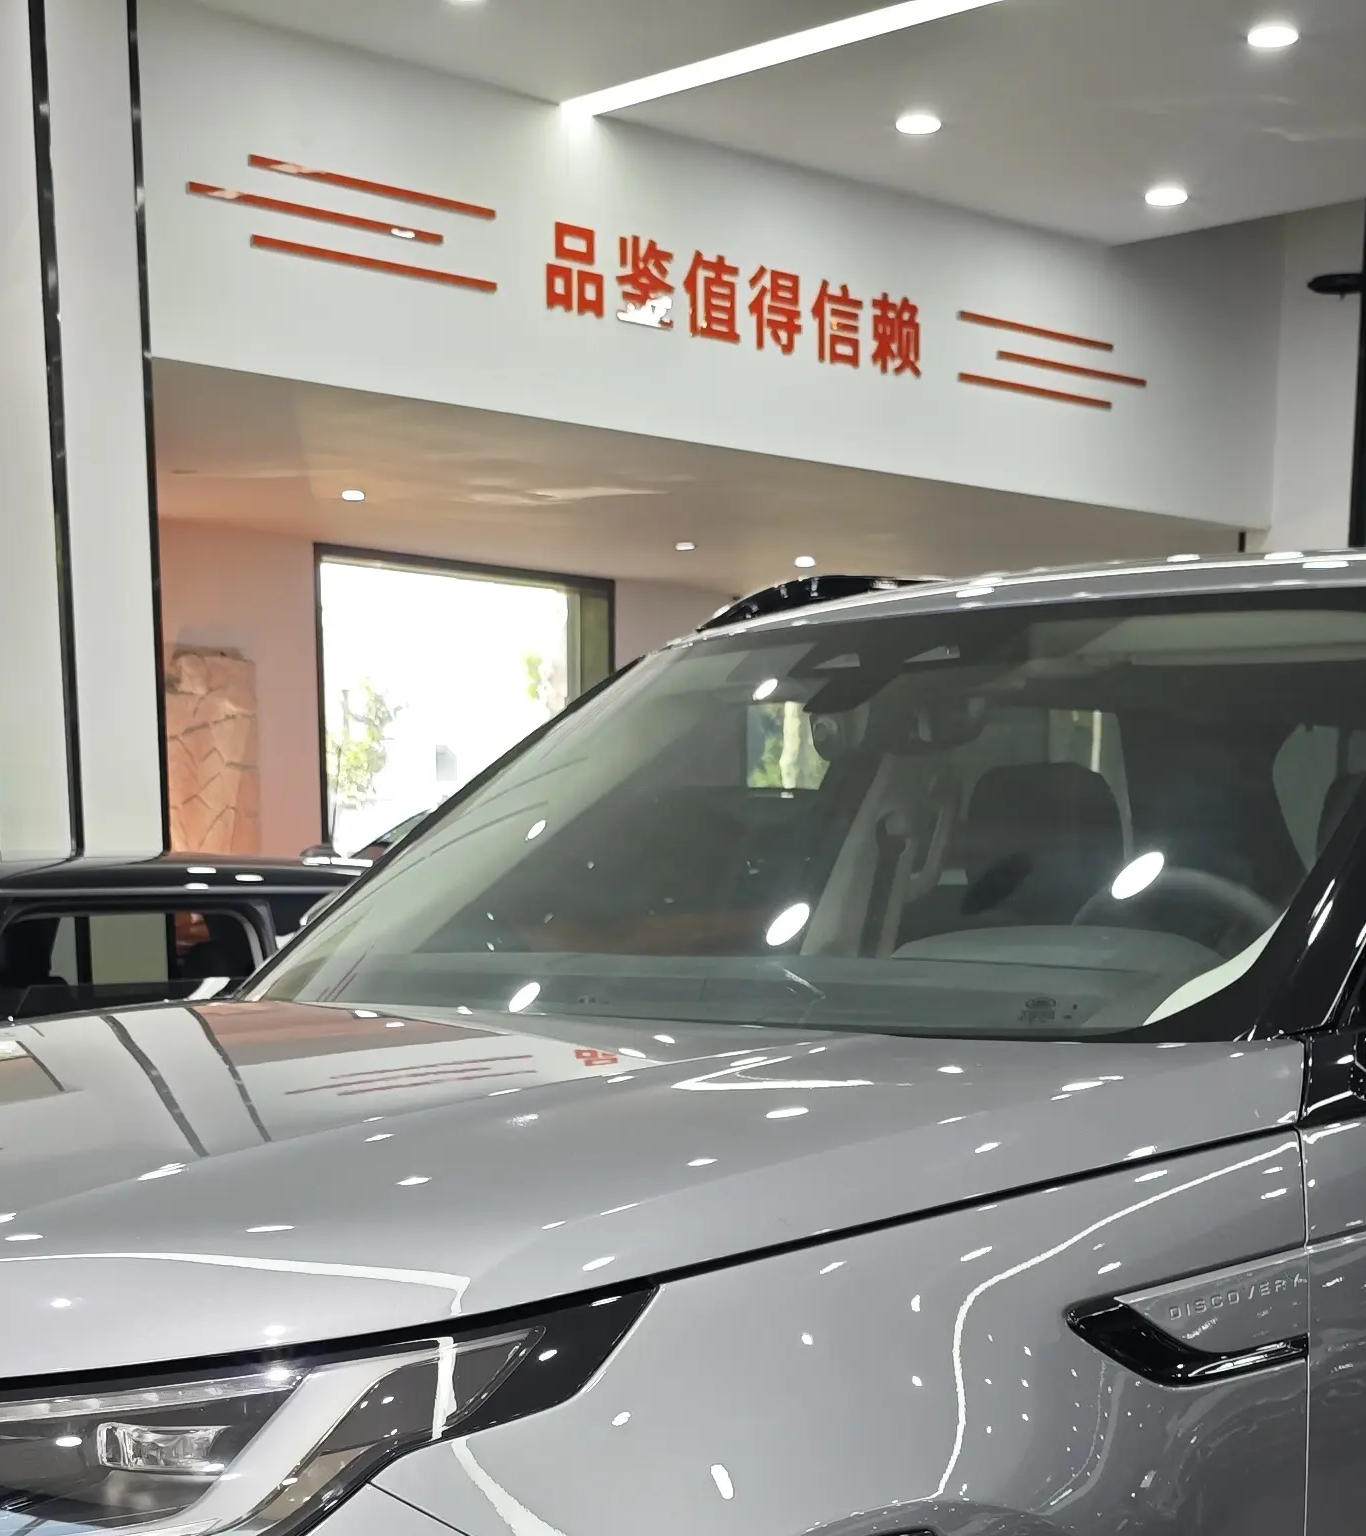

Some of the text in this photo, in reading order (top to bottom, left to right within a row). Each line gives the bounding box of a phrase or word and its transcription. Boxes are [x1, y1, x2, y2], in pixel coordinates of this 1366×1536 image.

[545, 221, 922, 378] 品鉴值得信赖
[1169, 1273, 1303, 1321] DISCOVERY
